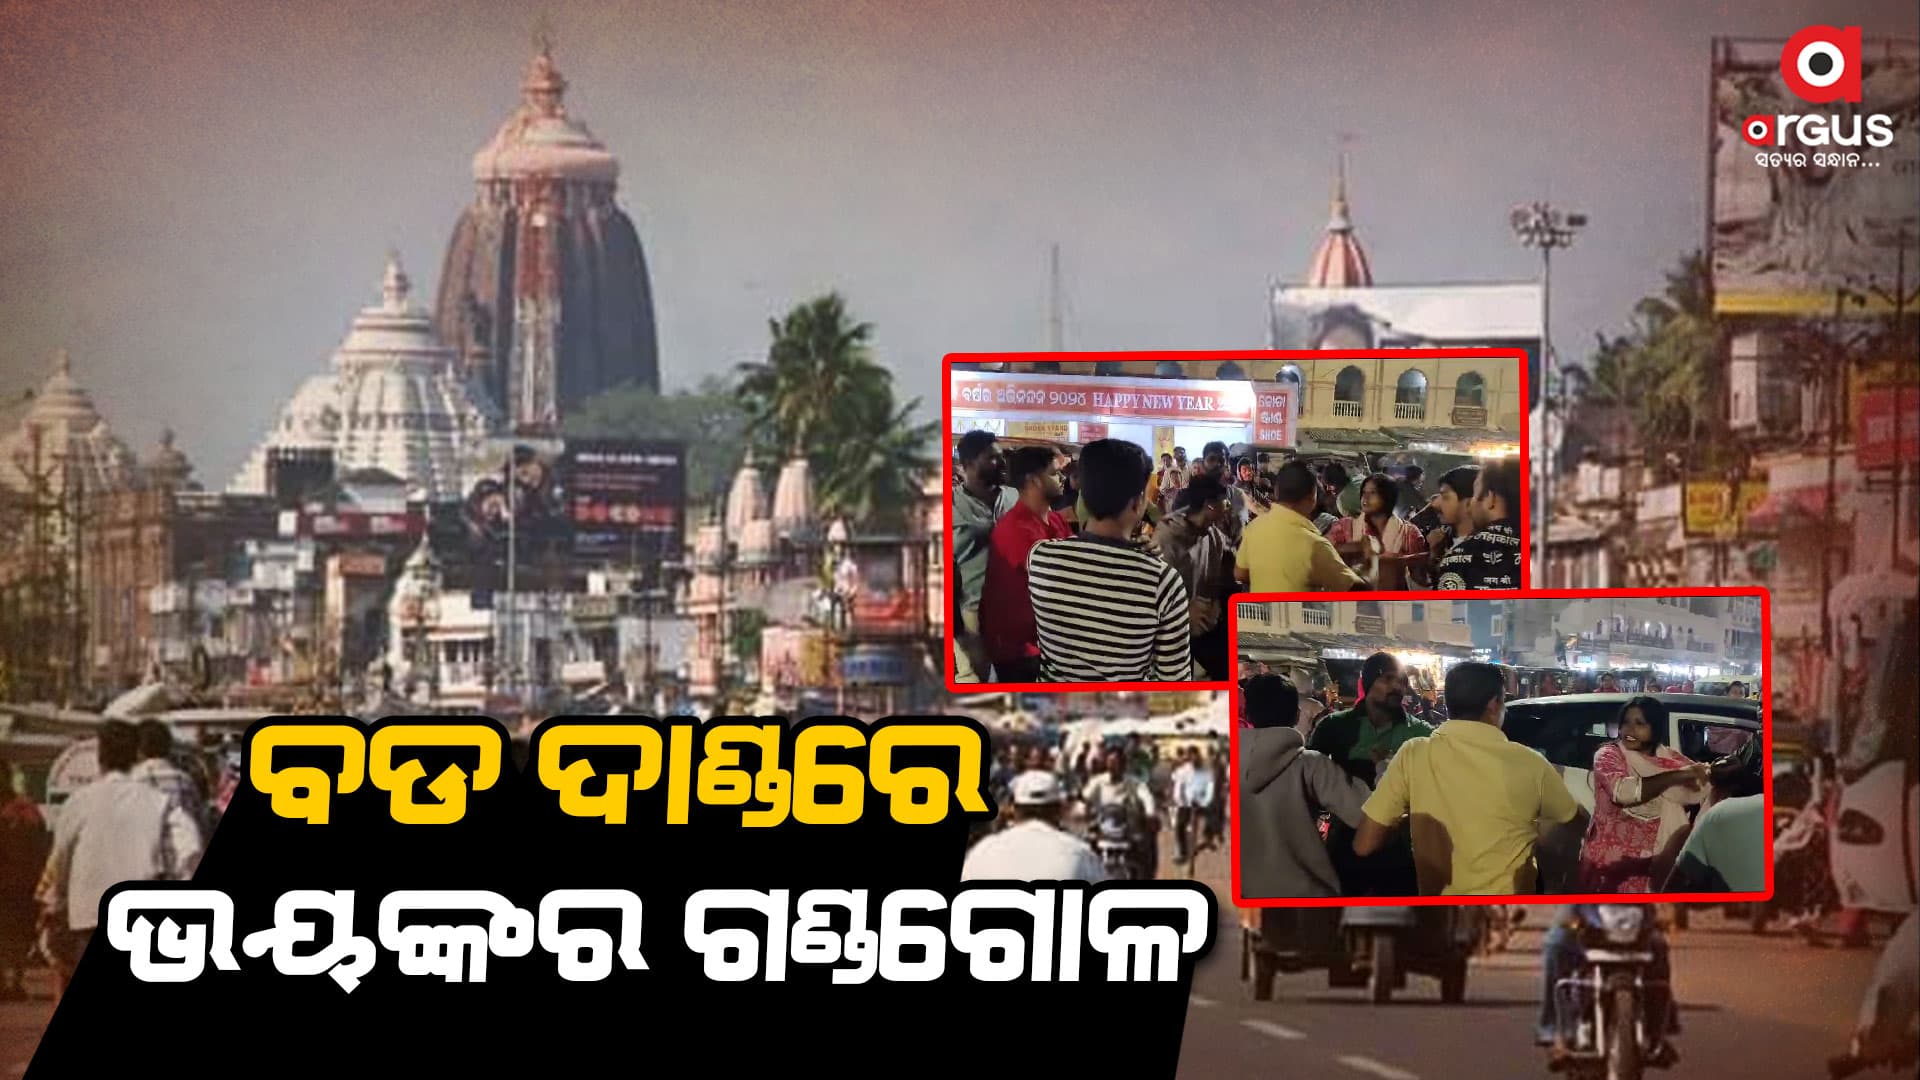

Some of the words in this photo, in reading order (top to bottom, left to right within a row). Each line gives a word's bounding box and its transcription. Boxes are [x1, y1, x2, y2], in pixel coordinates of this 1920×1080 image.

[1093, 391, 1142, 408] HAPPY
[1143, 394, 1174, 409] NEW
[1176, 395, 1214, 411] YEAR
